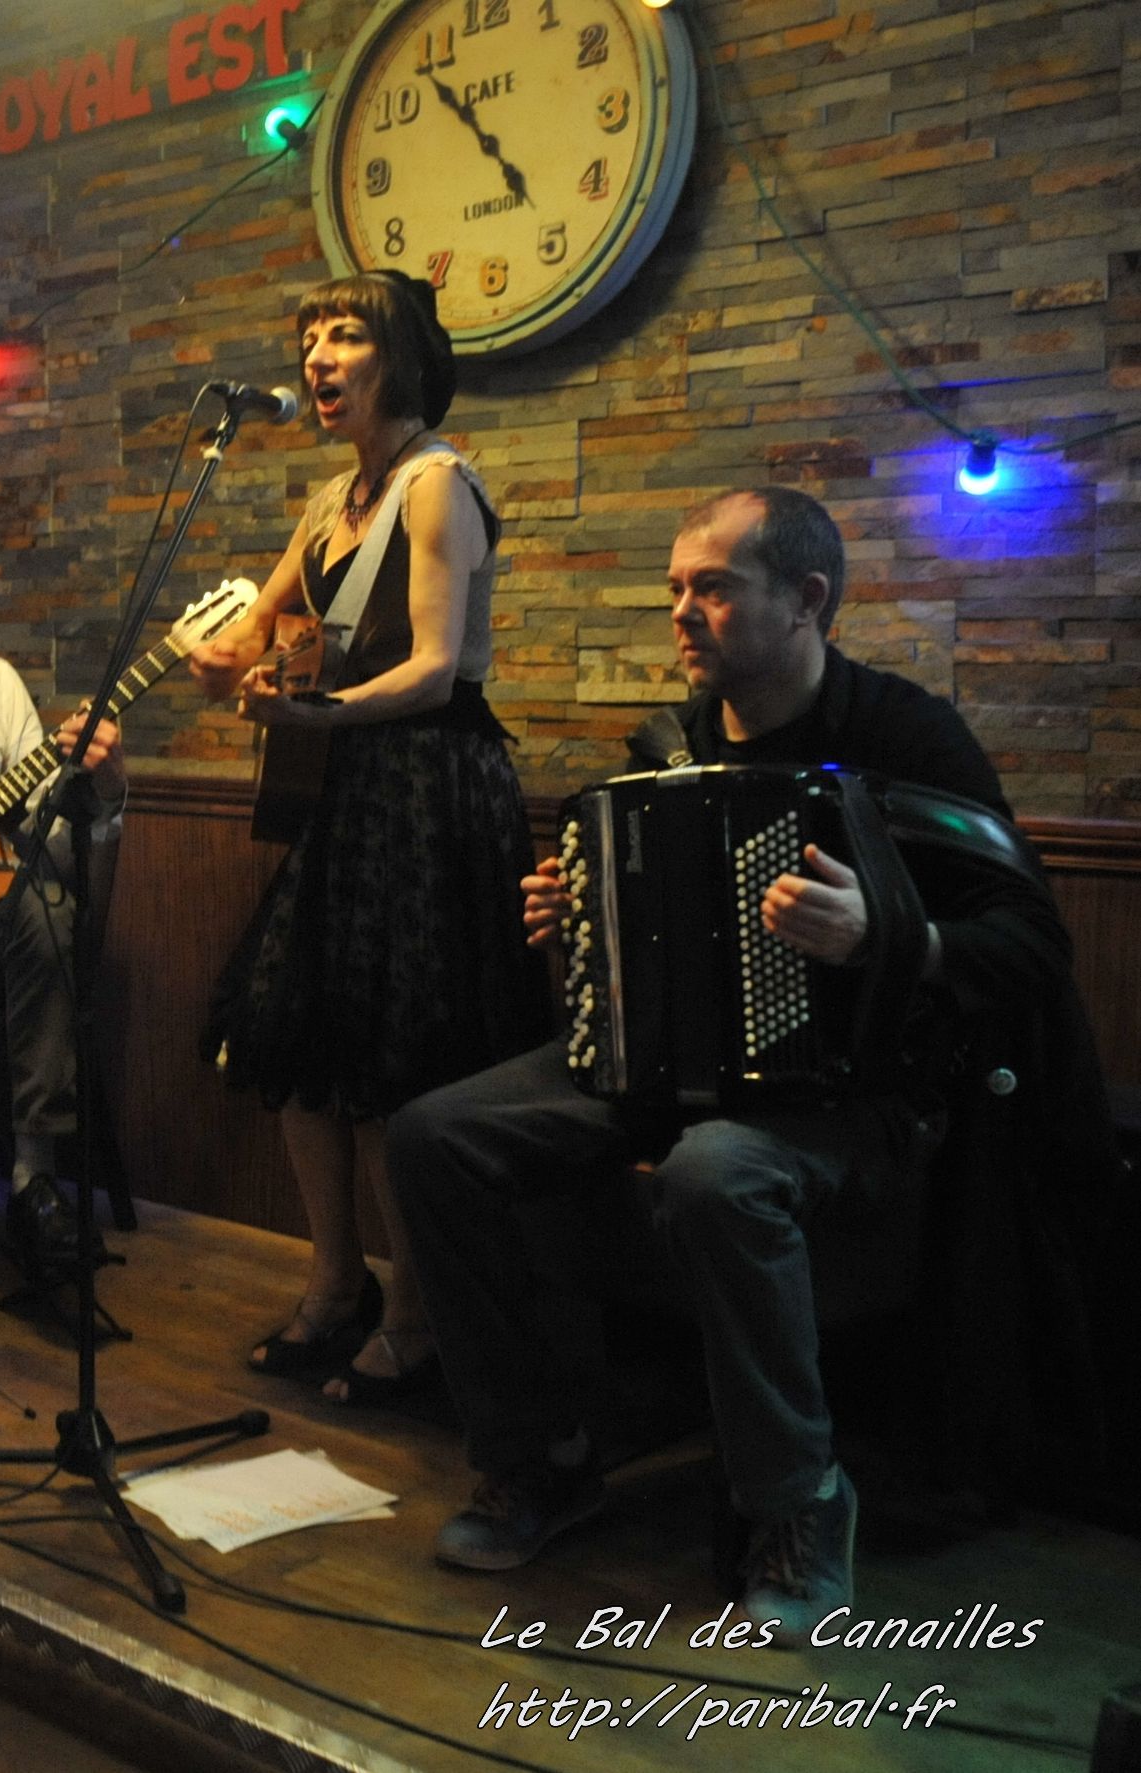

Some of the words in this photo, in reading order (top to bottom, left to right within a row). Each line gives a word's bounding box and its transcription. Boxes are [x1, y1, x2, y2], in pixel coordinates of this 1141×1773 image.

[462, 0, 510, 36] 12
[166, 0, 302, 106] EST
[416, 25, 455, 75] 11
[577, 23, 609, 69] 2
[373, 84, 421, 132] 10
[464, 70, 516, 105] CAFE
[597, 88, 630, 134] 3
[365, 157, 391, 197] 9
[578, 157, 610, 201] 4
[463, 192, 526, 222] LONDON
[384, 217, 405, 257] 8
[537, 221, 568, 264] 5
[427, 251, 453, 290] 7
[480, 256, 508, 298] 6
